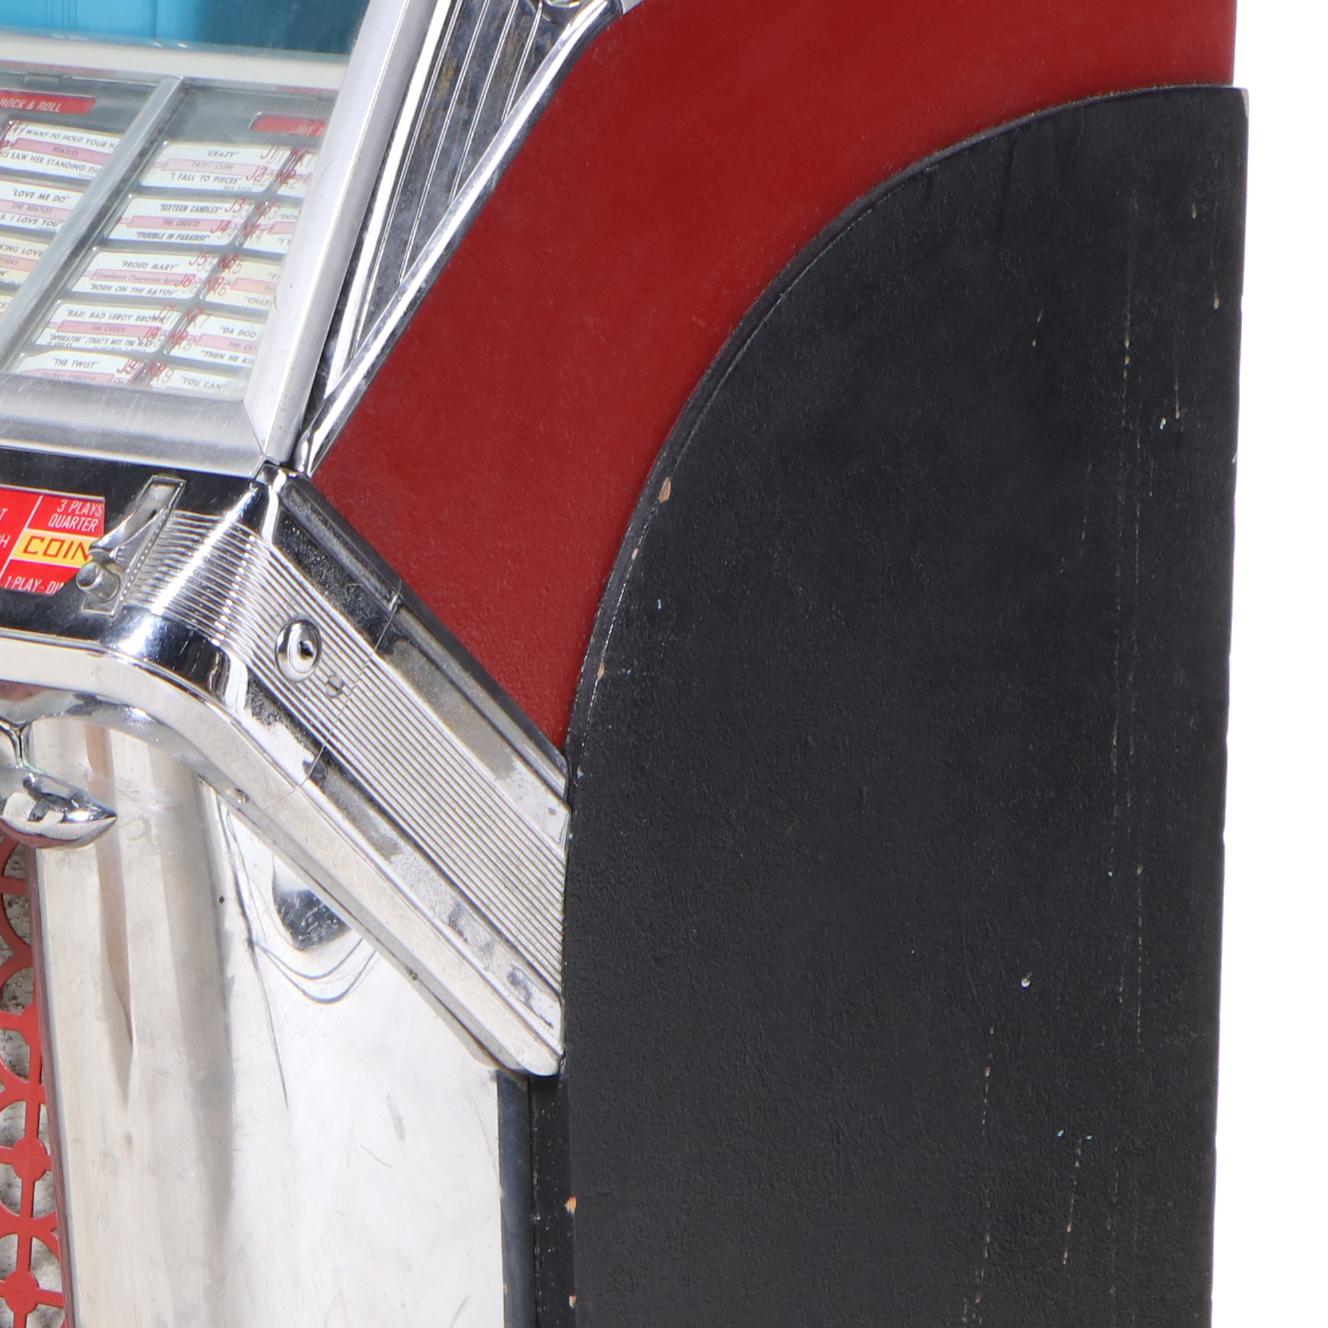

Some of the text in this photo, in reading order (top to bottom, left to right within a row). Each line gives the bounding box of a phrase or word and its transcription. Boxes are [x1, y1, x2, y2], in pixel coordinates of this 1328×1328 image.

[199, 176, 210, 184] TO
[57, 499, 104, 517] 3 PLAYS
[48, 513, 99, 533] QUARTER
